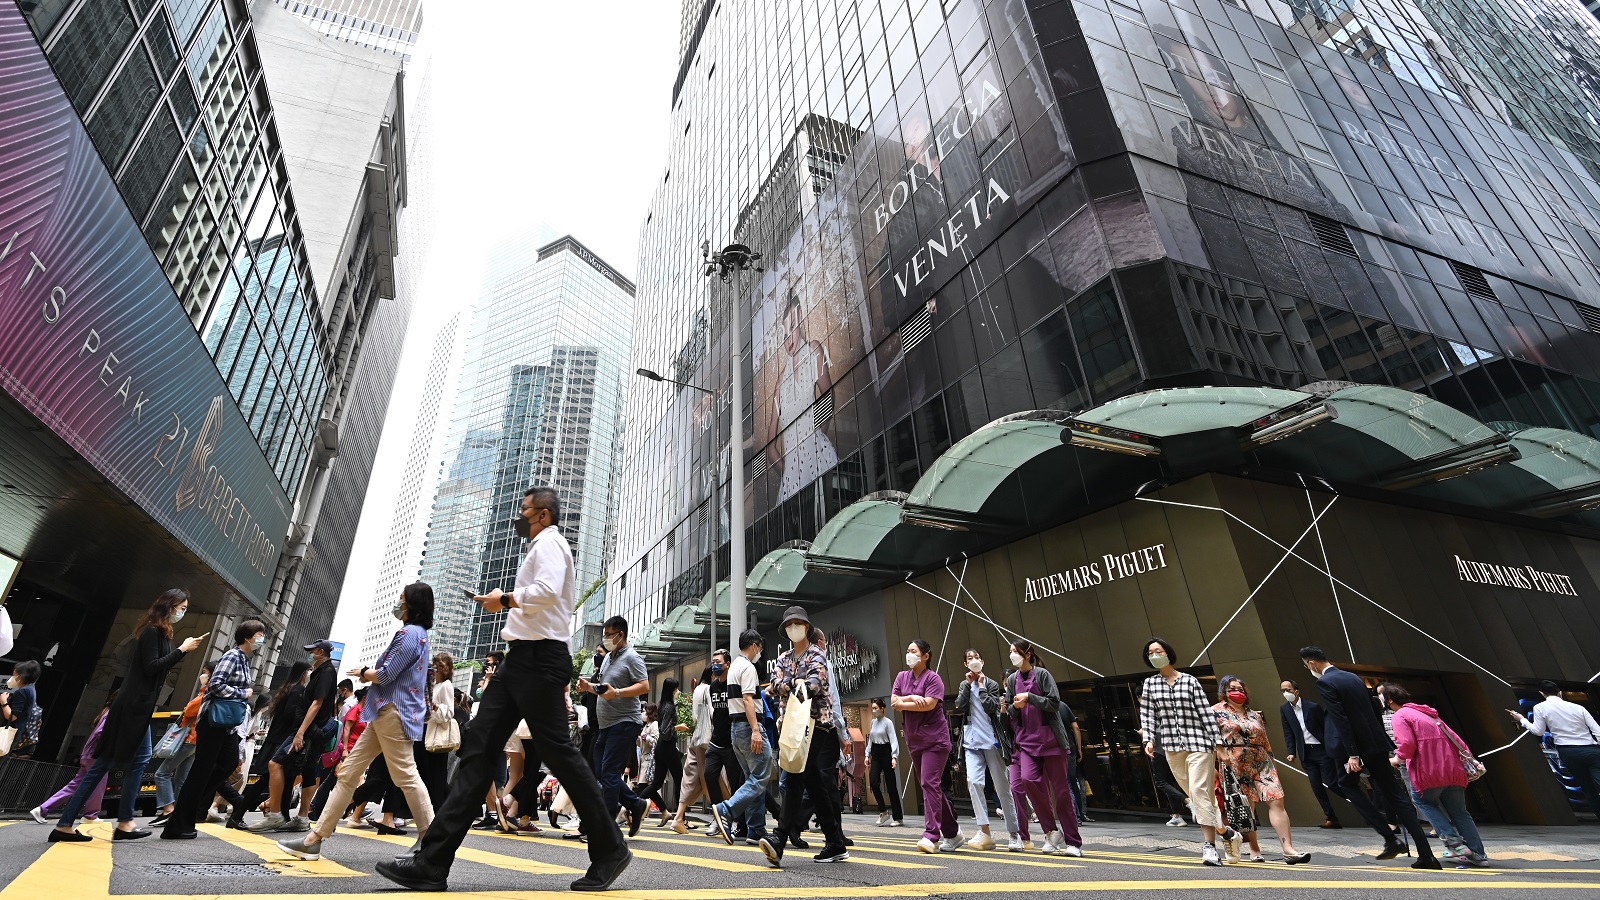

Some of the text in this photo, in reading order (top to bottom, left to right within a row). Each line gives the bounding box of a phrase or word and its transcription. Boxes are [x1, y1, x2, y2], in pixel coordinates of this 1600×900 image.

[873, 79, 1003, 236] BOTTEGA
[1170, 114, 1315, 188] VENETA
[1342, 119, 1480, 188] BOTTEGA
[893, 177, 1011, 299] VENETA
[1396, 194, 1519, 262] VENETA
[78, 328, 150, 426] PEAK
[153, 411, 189, 475] 21
[244, 522, 275, 577] ROAD
[1024, 543, 1168, 603] AUDEMARS PIGUET
[1454, 554, 1579, 597] AUDEMARS PIGUET
